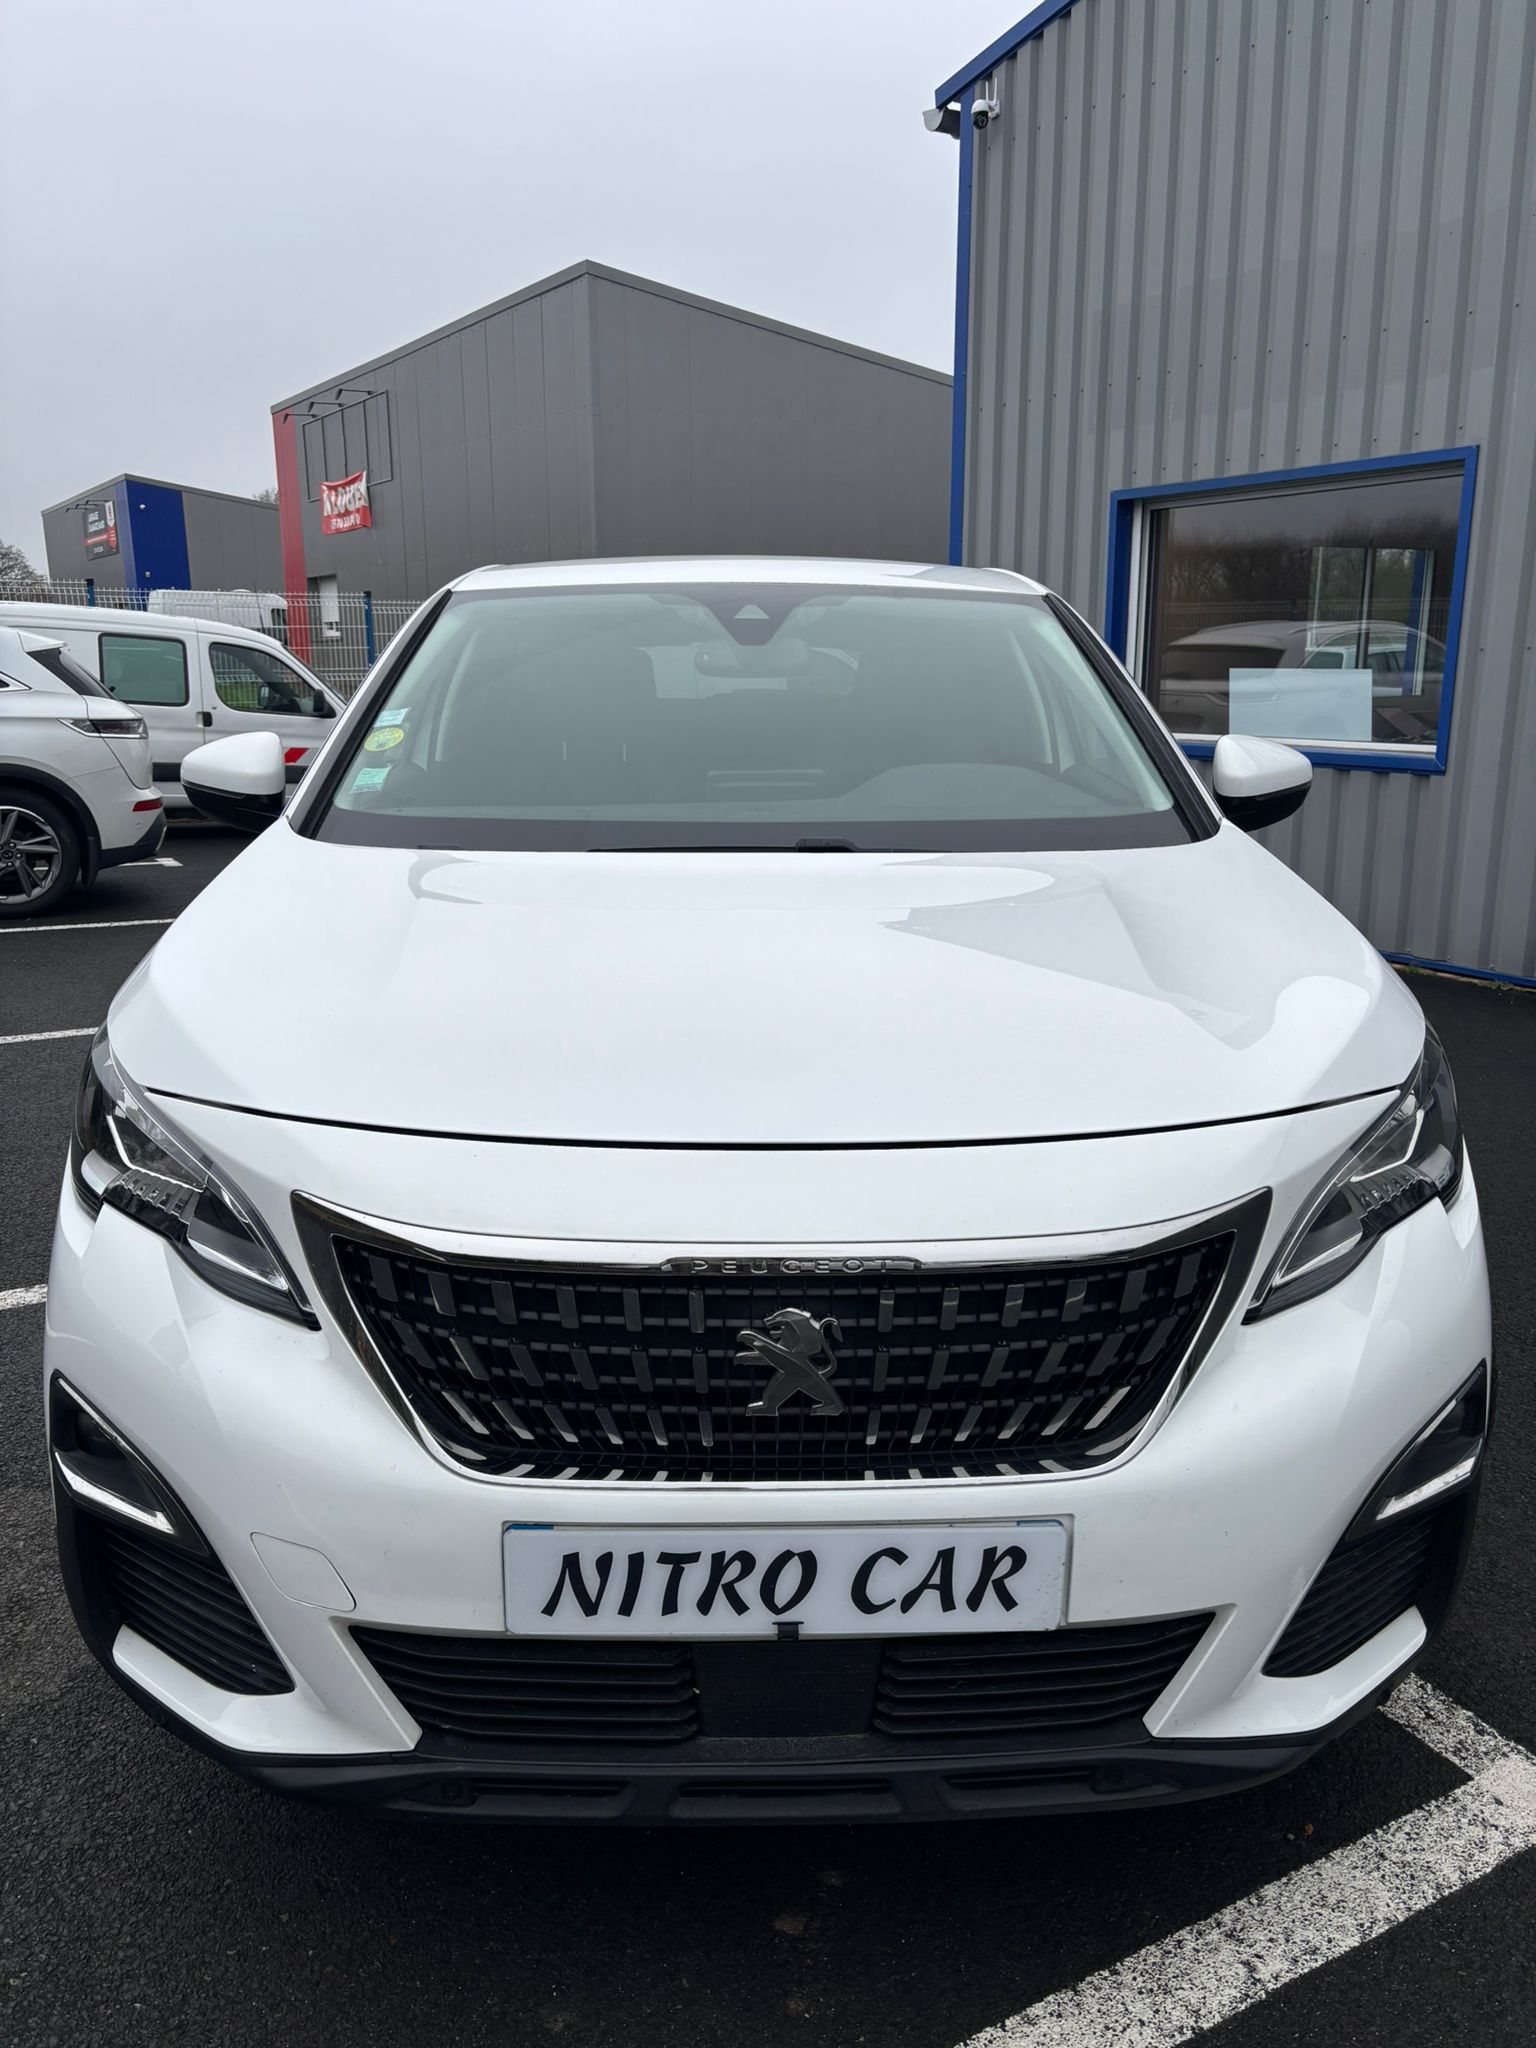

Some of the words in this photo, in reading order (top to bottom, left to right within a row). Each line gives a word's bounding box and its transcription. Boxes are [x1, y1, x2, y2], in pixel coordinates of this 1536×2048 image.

[690, 1258, 894, 1274] PEUGEOT
[540, 1548, 818, 1618] NITRO
[850, 1545, 1028, 1616] CAR
